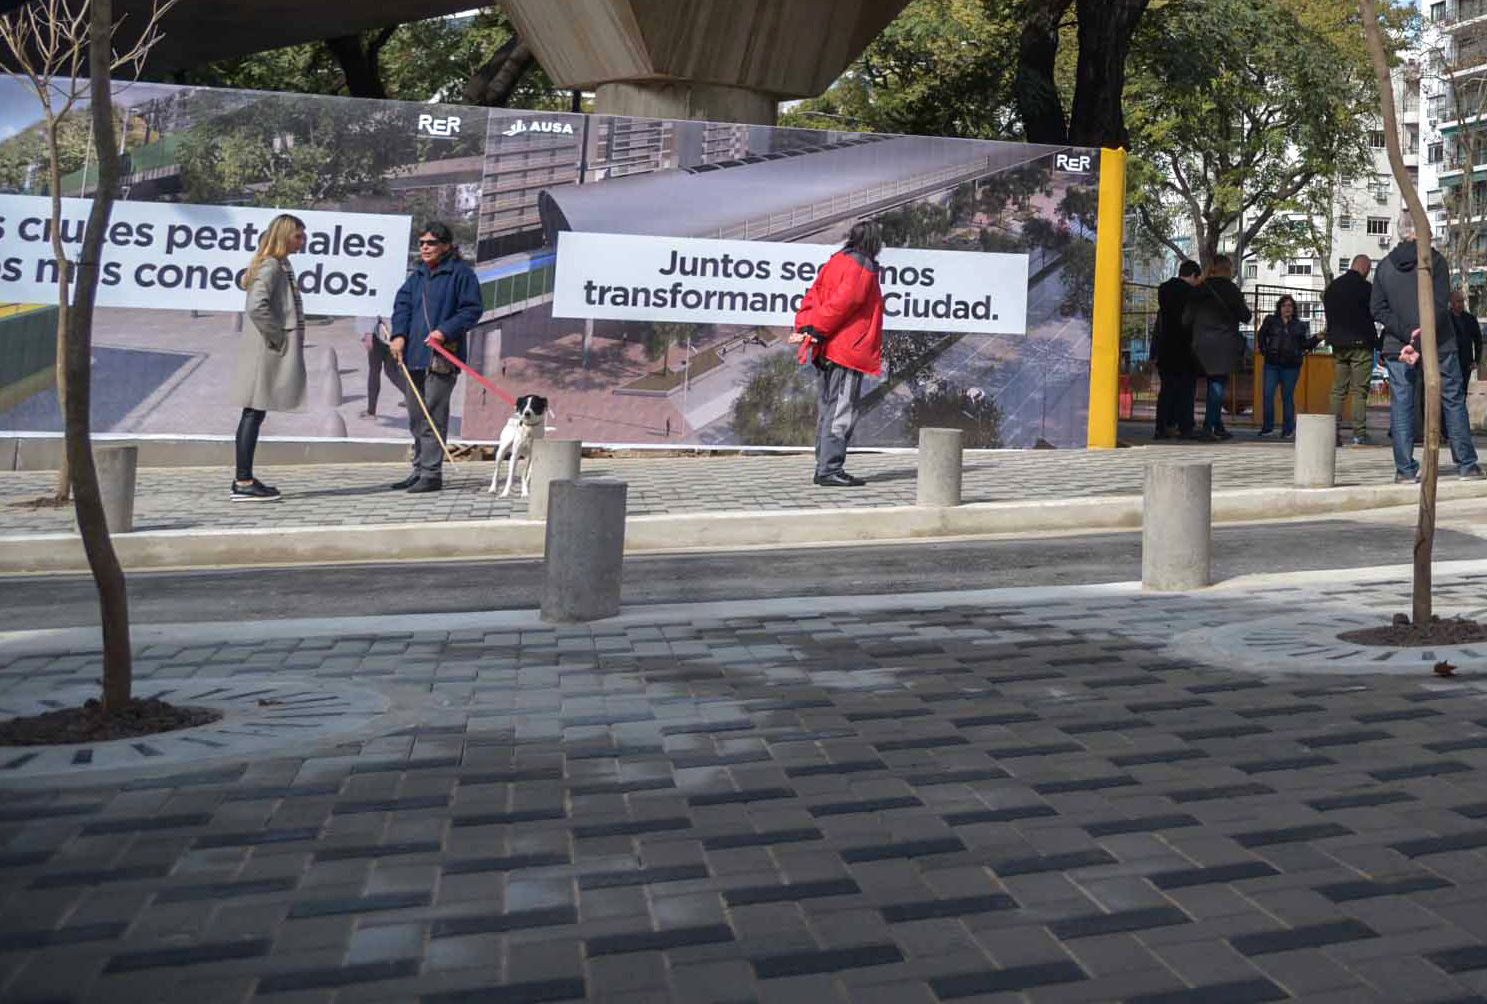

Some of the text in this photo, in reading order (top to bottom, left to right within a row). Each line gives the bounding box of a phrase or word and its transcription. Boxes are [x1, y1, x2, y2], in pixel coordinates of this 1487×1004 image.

[418, 114, 461, 136] RER
[529, 122, 573, 134] AUSA
[1057, 154, 1090, 172] RER
[18, 216, 154, 247] crues
[166, 223, 385, 258] peatales
[0, 257, 23, 282] s
[35, 252, 122, 286] ms
[659, 250, 935, 287] Juntos semos
[883, 292, 999, 321] Ciudad.
